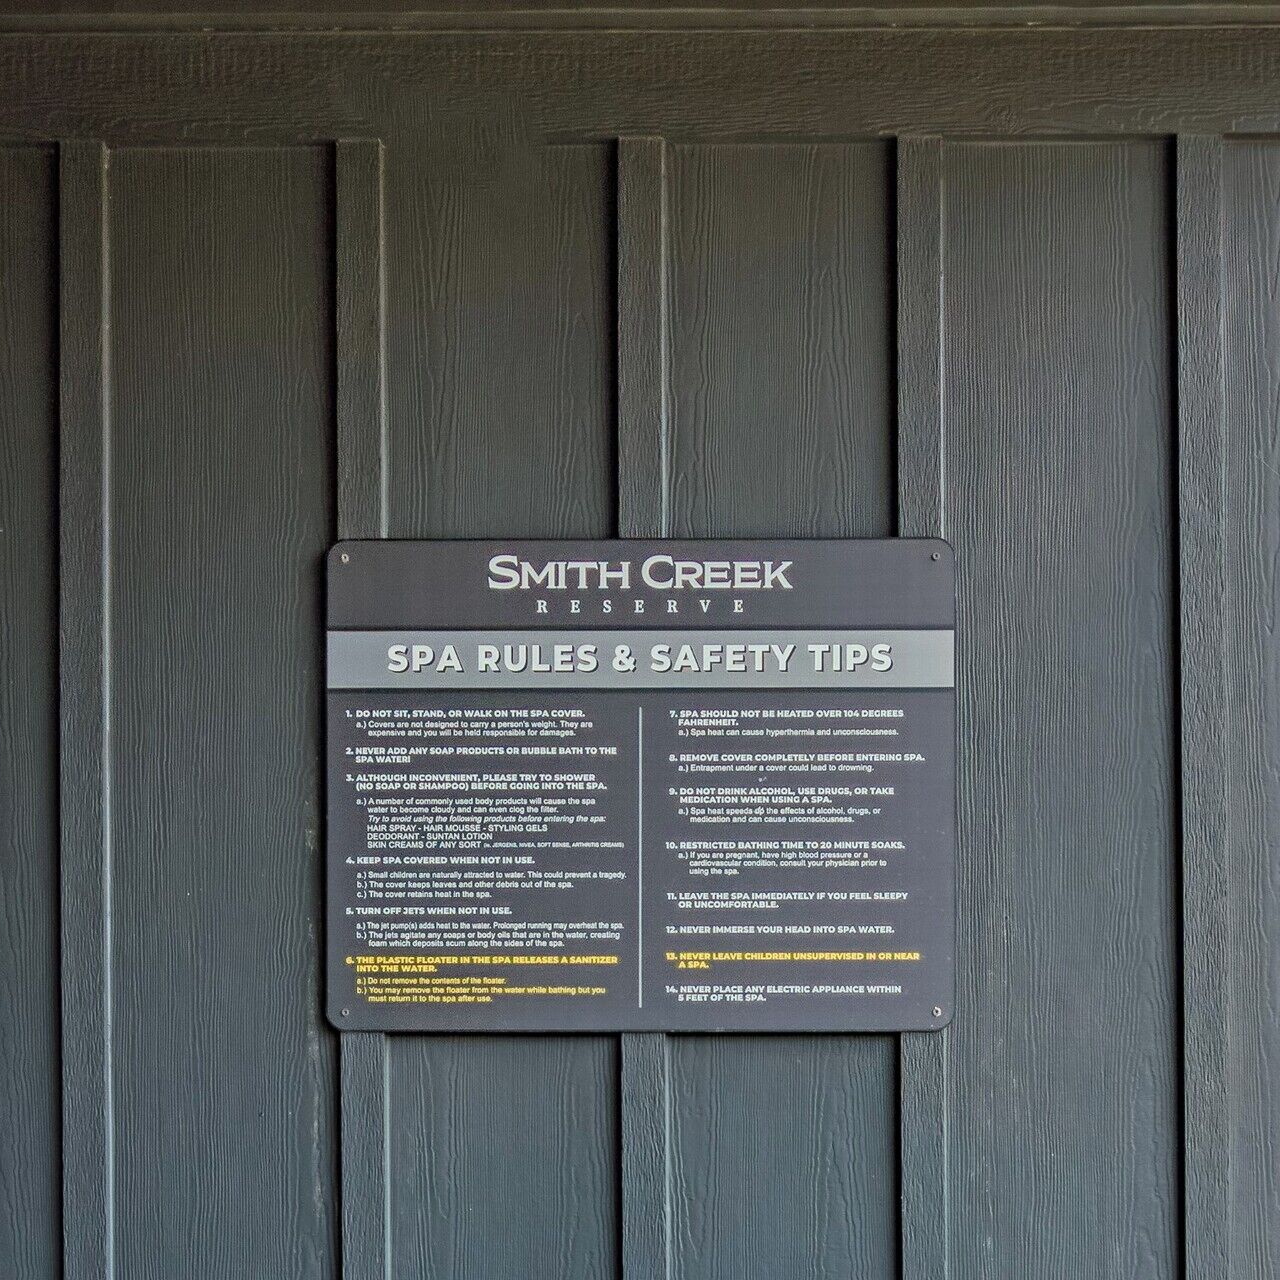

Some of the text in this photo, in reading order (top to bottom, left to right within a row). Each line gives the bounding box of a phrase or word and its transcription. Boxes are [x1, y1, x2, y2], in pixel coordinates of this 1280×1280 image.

[487, 554, 794, 590] SMITH CREEK
[536, 599, 745, 614] RESERVE
[387, 644, 894, 674] SPA RULES & SAFETY TIPS
[393, 710, 411, 718] SIT,
[412, 710, 447, 718] STAND,
[669, 710, 904, 718] 7. SPA SHOULD NOT BE HEATED OVER 104 DEGREES
[678, 718, 739, 726] FAHRENHEIT.
[679, 754, 720, 762] REMOVE
[720, 754, 753, 762] COVER
[754, 754, 816, 762] COMPLETELY
[817, 754, 854, 762] BEFORE
[855, 754, 902, 762] ENTERING
[903, 754, 926, 762] SPA.
[409, 774, 481, 782] INCONVENIENT,
[356, 782, 607, 791] (NO SOAP OR SHAMPOO) BEFORE GOING INTO THE SPA.
[367, 824, 387, 832] HAIR
[388, 824, 417, 832] SPRAY
[423, 824, 444, 832] HAIR
[445, 824, 482, 832] MOUSSE
[488, 824, 524, 832] STYLING
[525, 824, 548, 832] GELS
[356, 856, 382, 864] KEEP
[382, 856, 402, 864] SPA
[403, 856, 448, 864] COVERED
[449, 856, 480, 864] WHEN
[480, 856, 501, 864] NOT
[502, 856, 513, 864] IN
[514, 856, 535, 864] USE.
[678, 892, 709, 900] LEAVE
[710, 892, 729, 900] THE
[730, 892, 750, 900] SPA
[751, 892, 815, 900] IMMEDIATELY
[816, 892, 826, 900] IF
[827, 892, 848, 900] YOU
[849, 892, 872, 900] FEEL
[873, 892, 908, 900] SLEEPY
[678, 900, 779, 908] OR UNCOMFORTABLE.
[355, 907, 382, 915] TURN
[383, 907, 402, 915] OFF
[403, 907, 426, 915] JETS
[426, 907, 457, 915] WHEN
[458, 907, 478, 915] NOT
[479, 907, 490, 915] IN
[491, 907, 512, 915] USE.
[679, 926, 711, 934] NEVER
[712, 926, 755, 934] IMMERSE
[756, 926, 783, 934] YOUR
[784, 926, 811, 934] HEAD
[812, 926, 836, 934] INTO
[837, 926, 857, 934] SPA
[858, 926, 894, 934] WATER.
[356, 956, 375, 964] THE
[376, 956, 415, 964] PLASTIC
[416, 956, 459, 964] FLOATER
[460, 956, 471, 964] IN
[472, 956, 491, 964] THE
[492, 956, 511, 964] SPA
[512, 956, 559, 964] RELEASES
[560, 956, 568, 964] A
[569, 956, 618, 964] SANITIZER
[686, 994, 709, 1002] FEET
[710, 994, 724, 1002] OF
[724, 994, 744, 1002] THE
[744, 994, 766, 1002] SPA.
